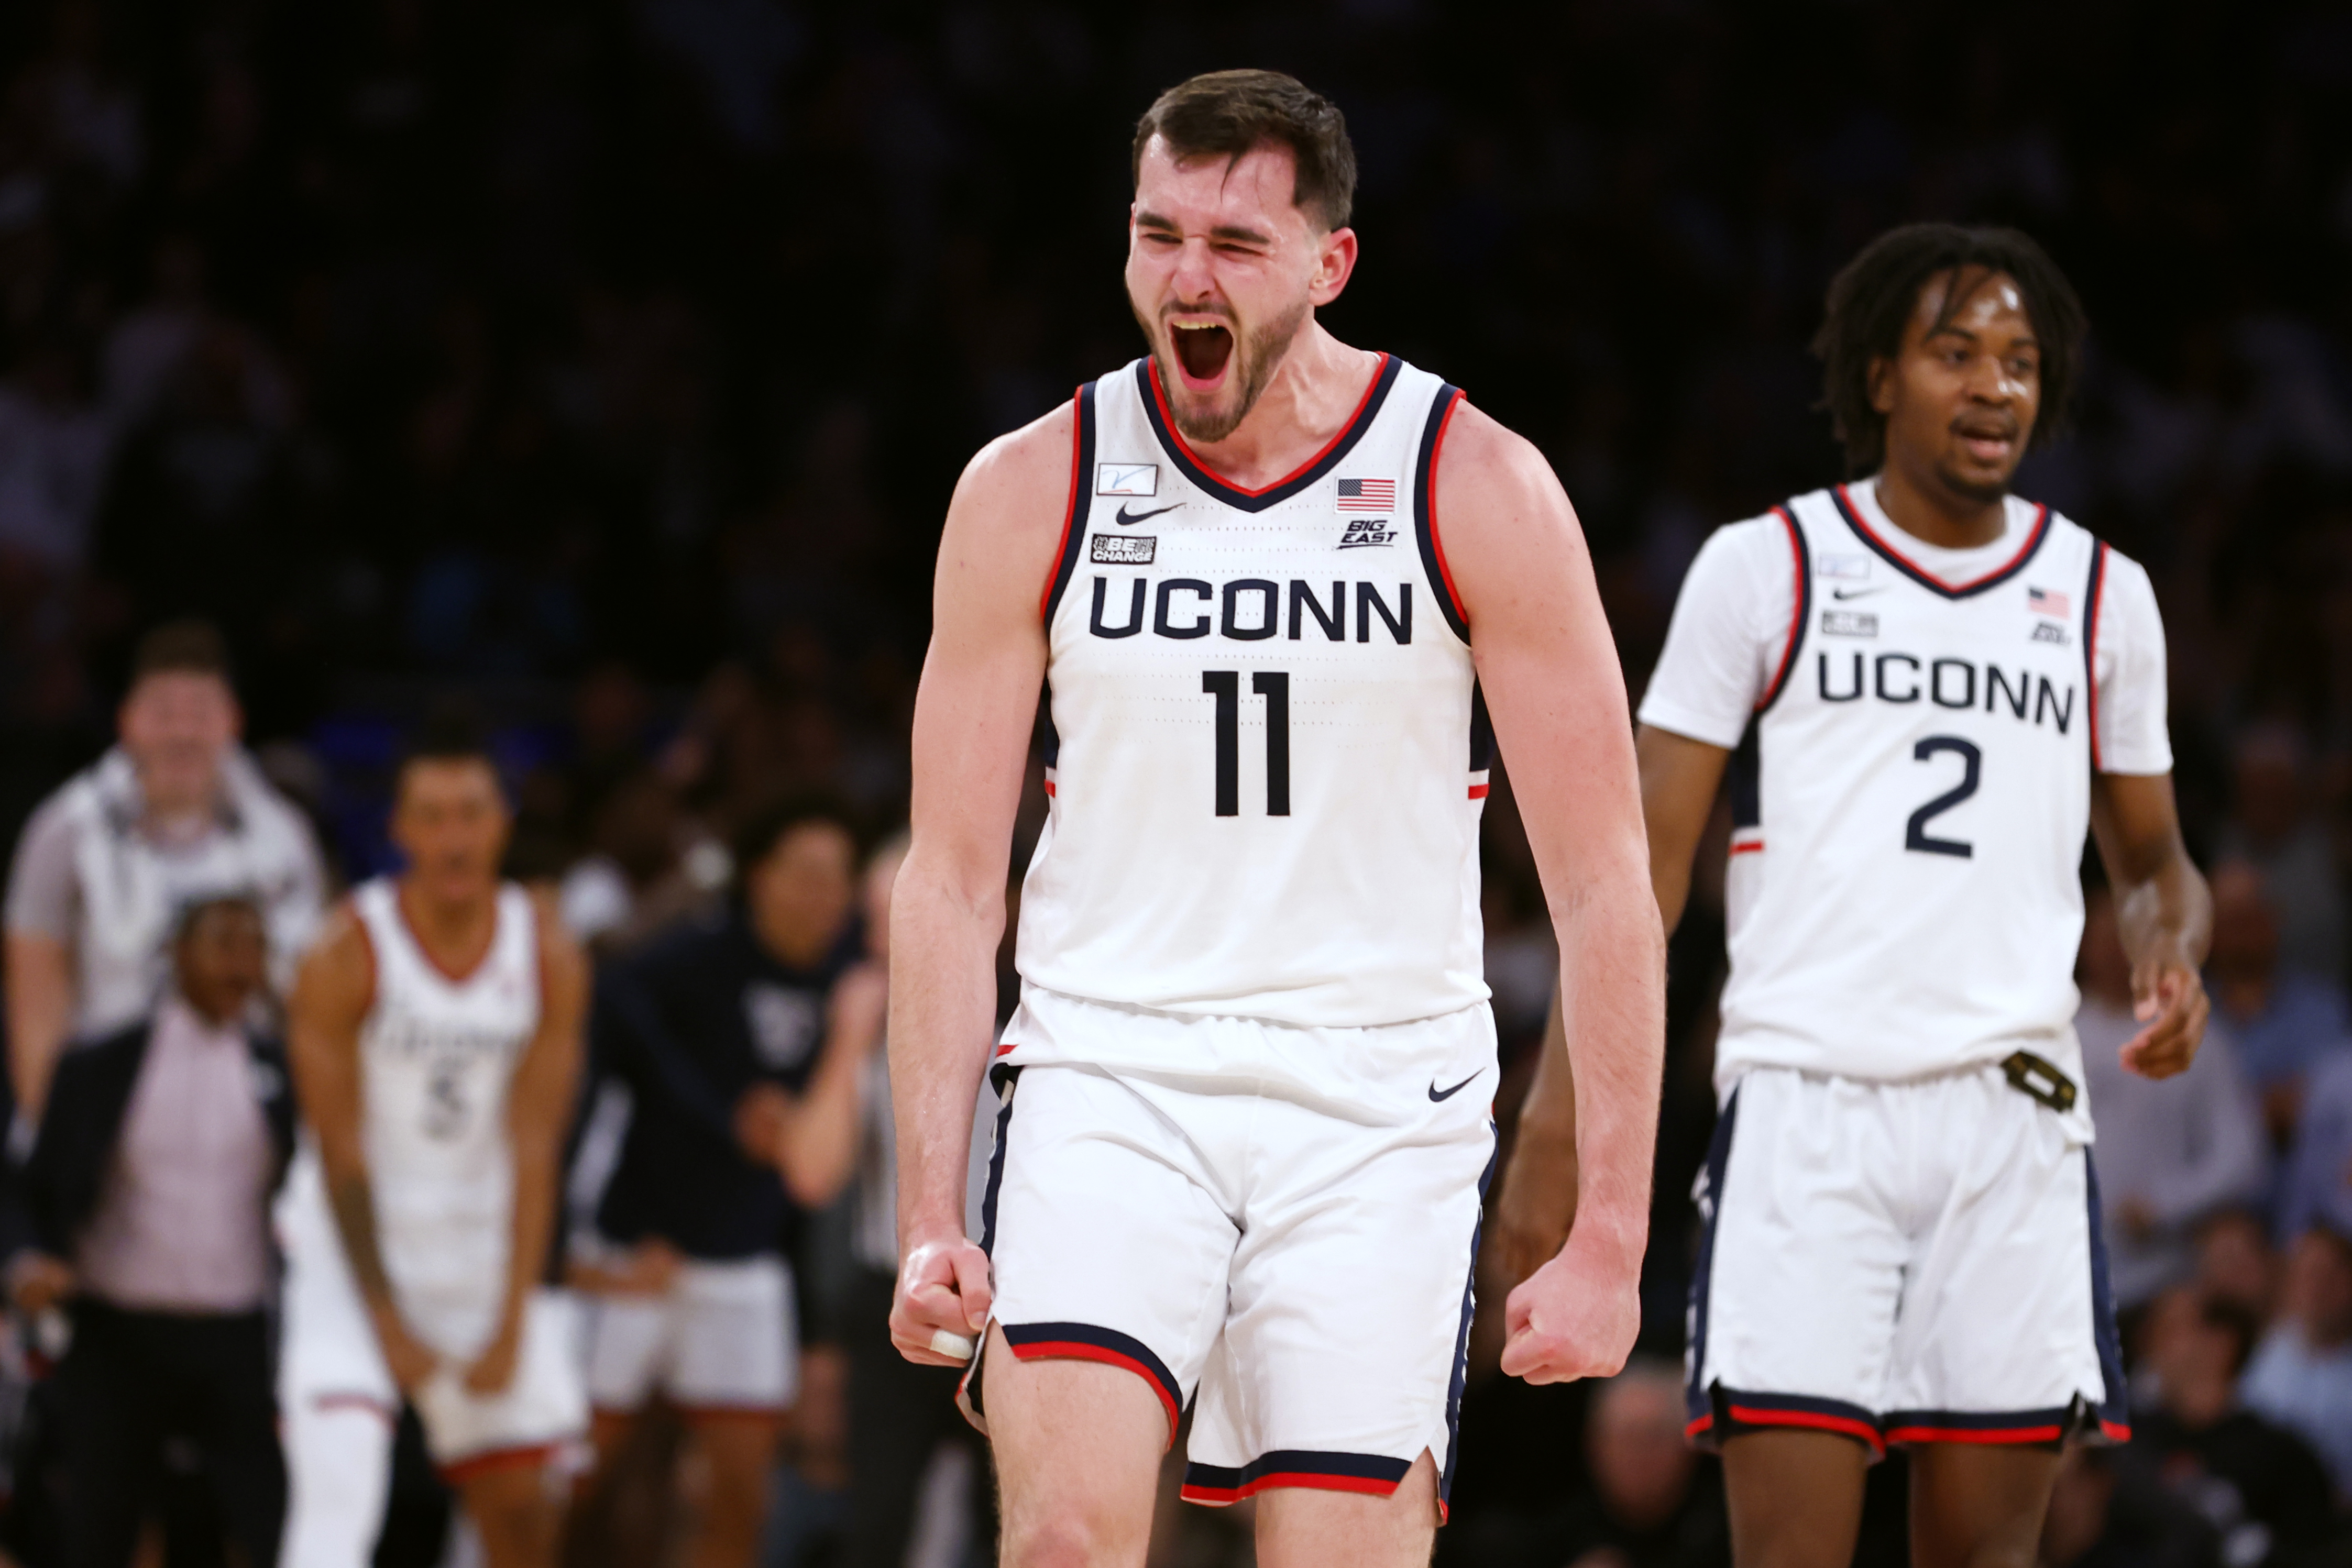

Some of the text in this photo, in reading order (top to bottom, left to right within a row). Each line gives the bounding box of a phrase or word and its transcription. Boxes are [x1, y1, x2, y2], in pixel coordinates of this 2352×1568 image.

[1092, 550, 1153, 562] CHANGE
[1340, 532, 1398, 543] EAST
[1347, 520, 1388, 532] BIG
[1090, 576, 1413, 645] UCONN
[1818, 653, 2075, 735] UCONN
[1202, 670, 1291, 817] 11
[1905, 735, 1982, 859] 2
